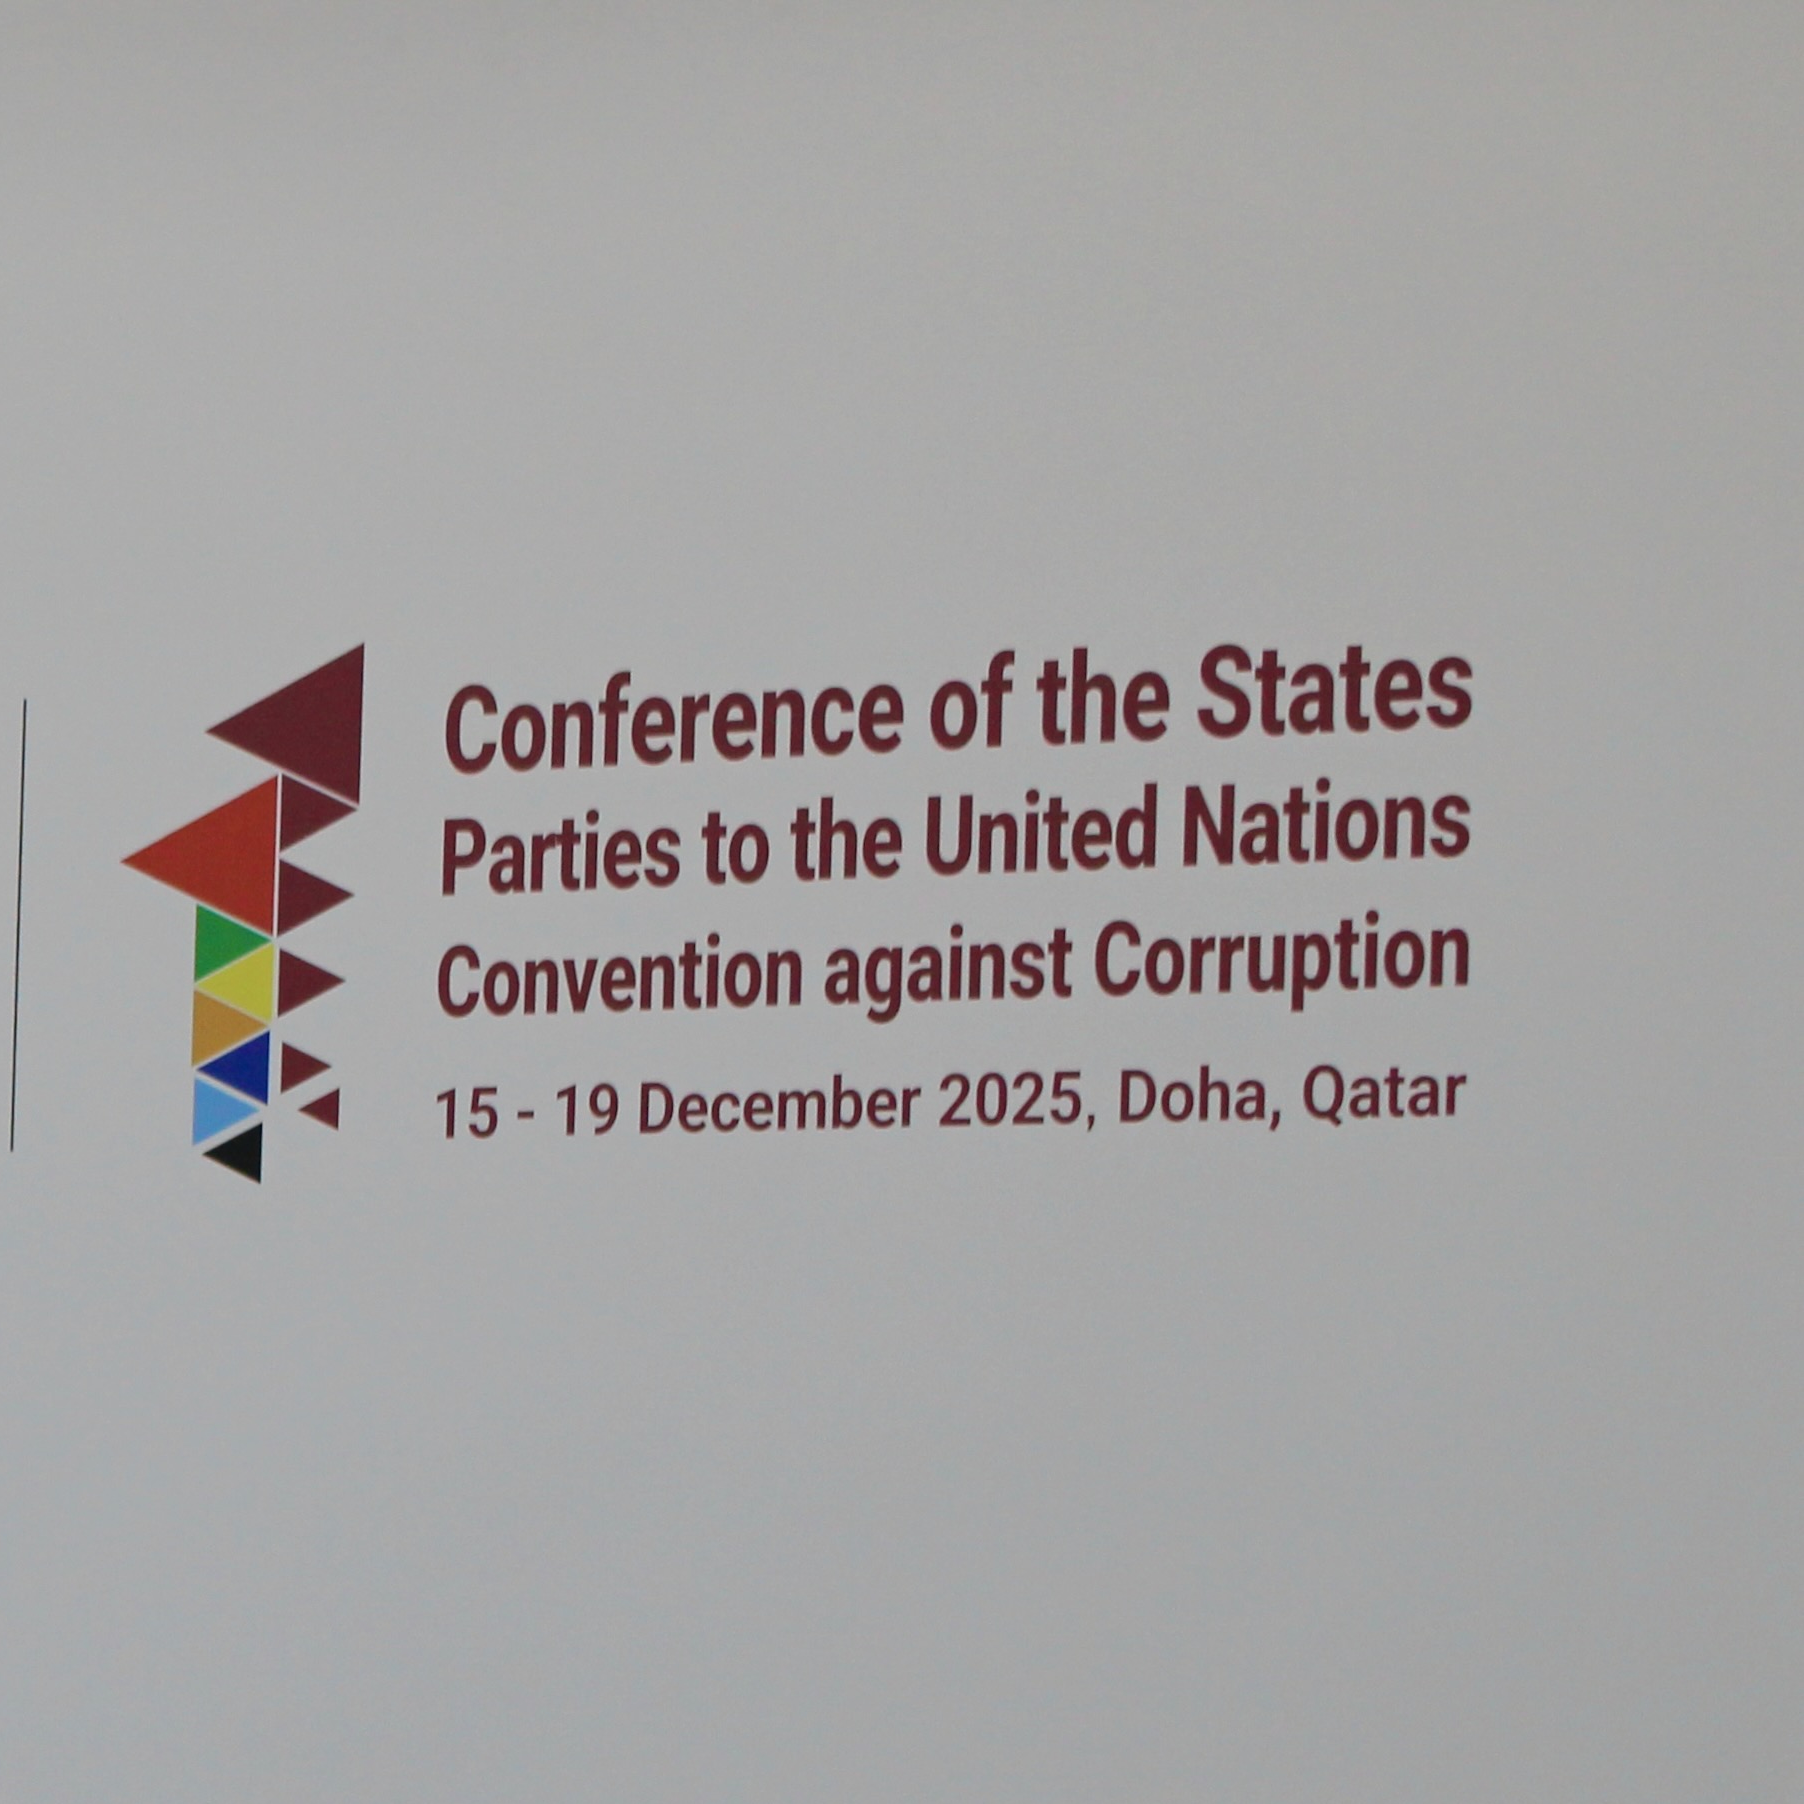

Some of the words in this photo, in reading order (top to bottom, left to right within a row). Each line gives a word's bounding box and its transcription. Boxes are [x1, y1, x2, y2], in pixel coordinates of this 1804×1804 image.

[446, 671, 904, 774] Conference
[930, 650, 1015, 750] of
[1037, 647, 1170, 745] the
[1198, 644, 1472, 738] States
[443, 809, 680, 895] Parties
[702, 812, 769, 885] to
[791, 797, 902, 881] the
[927, 783, 1157, 875] United
[1184, 777, 1470, 866] Nations
[438, 932, 802, 1017] Convention
[825, 924, 1072, 1023] against
[1095, 910, 1469, 1012] Corruption
[437, 1087, 497, 1138] 15
[557, 1083, 618, 1135] 19
[640, 1074, 921, 1133] December
[940, 1071, 1095, 1131] 2025,
[1120, 1065, 1280, 1131] Doha,
[1304, 1065, 1467, 1126] Qatar
